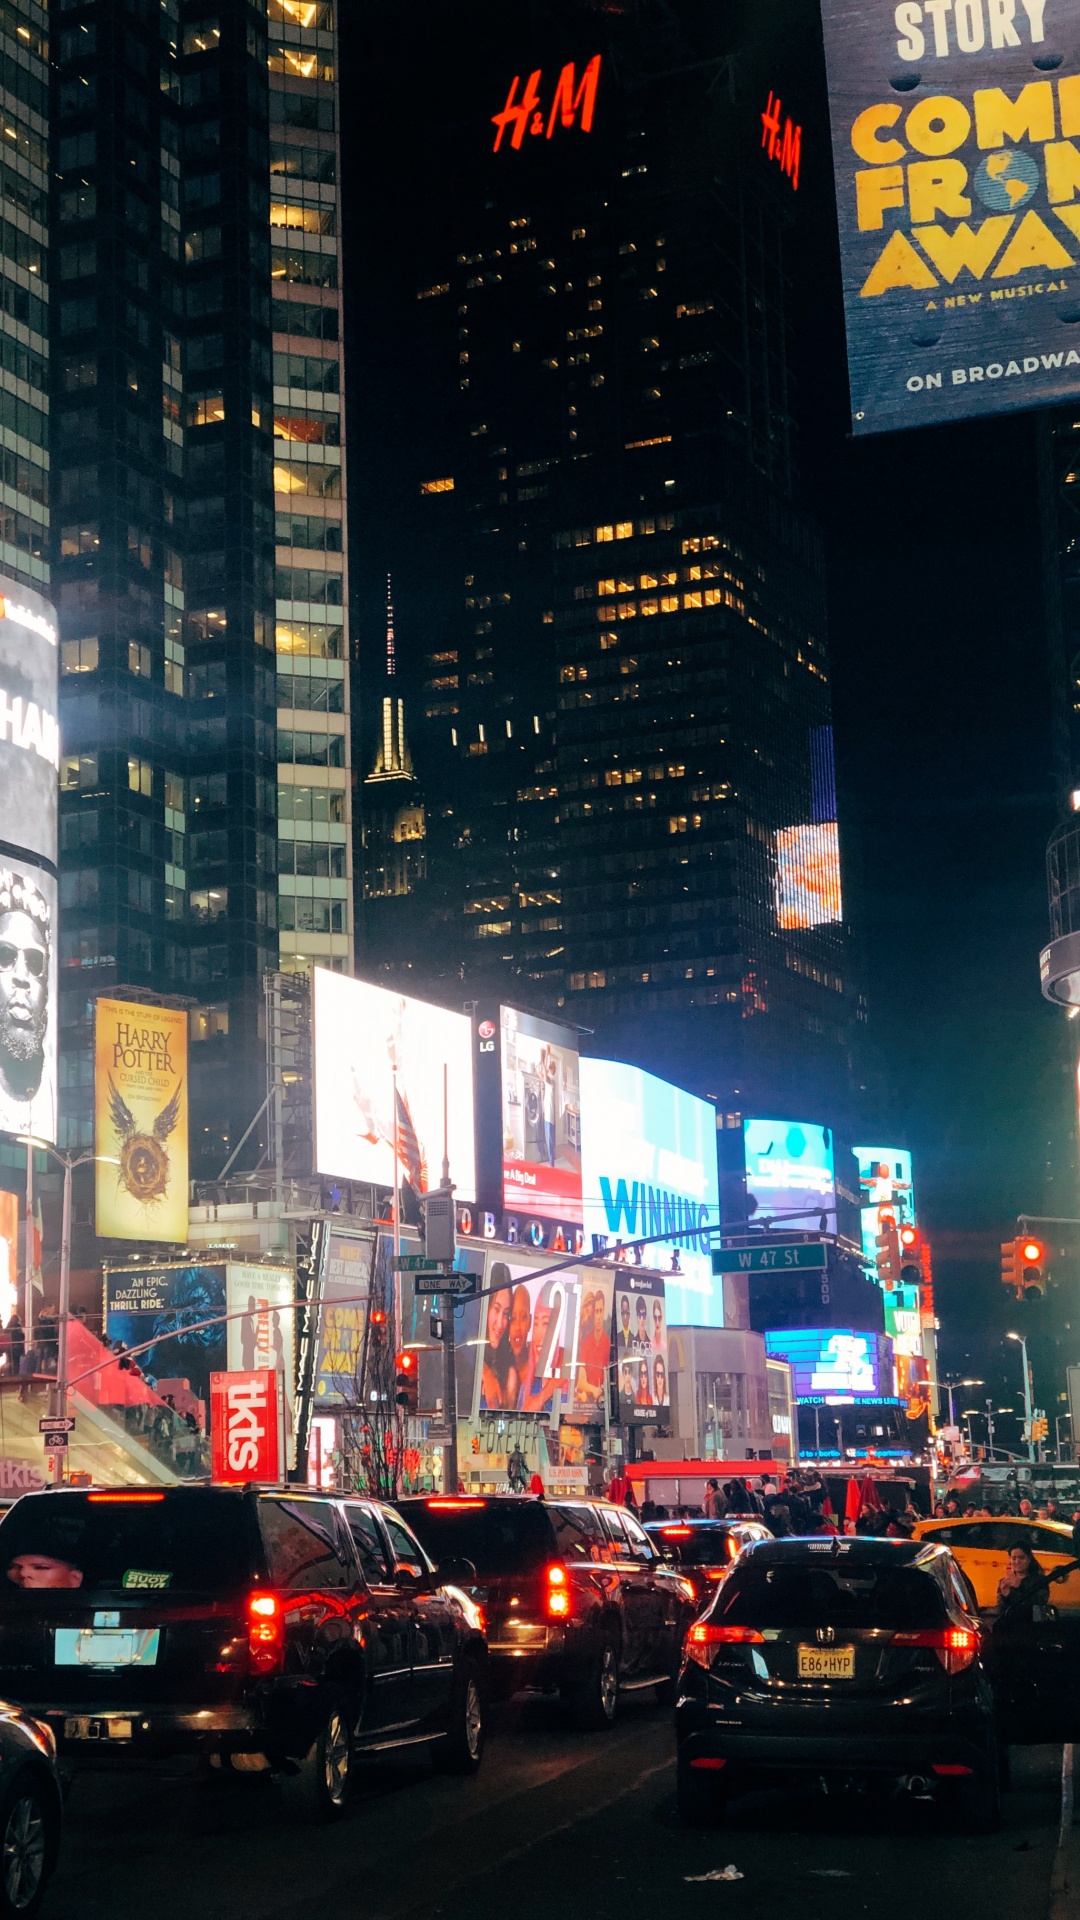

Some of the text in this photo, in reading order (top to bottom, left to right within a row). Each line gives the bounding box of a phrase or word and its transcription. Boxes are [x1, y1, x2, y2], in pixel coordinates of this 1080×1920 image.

[895, 0, 1047, 61] STORY
[491, 54, 602, 152] H&M
[761, 90, 801, 191] H&M
[925, 280, 1068, 311] A NEW MUSICAL
[906, 371, 942, 392] ON
[116, 1022, 172, 1052] HARRY
[480, 1041, 494, 1052] LG
[112, 1044, 176, 1074] POTTER
[120, 1073, 170, 1088] CURSED CHILD
[599, 1176, 712, 1255] WINNING
[401, 1257, 425, 1269] W 47
[738, 1250, 799, 1268] W 47 St
[115, 1288, 157, 1300] DAZZLING
[252, 1282, 264, 1290] TIME
[449, 1280, 467, 1288] WAY
[110, 1300, 139, 1311] THRILL
[325, 1307, 364, 1329] COME
[543, 1280, 582, 1379] 21
[632, 1340, 653, 1357] FACES
[320, 1351, 361, 1373] AWAY
[634, 1409, 646, 1417] HOUSE
[228, 1380, 266, 1471] tkts
